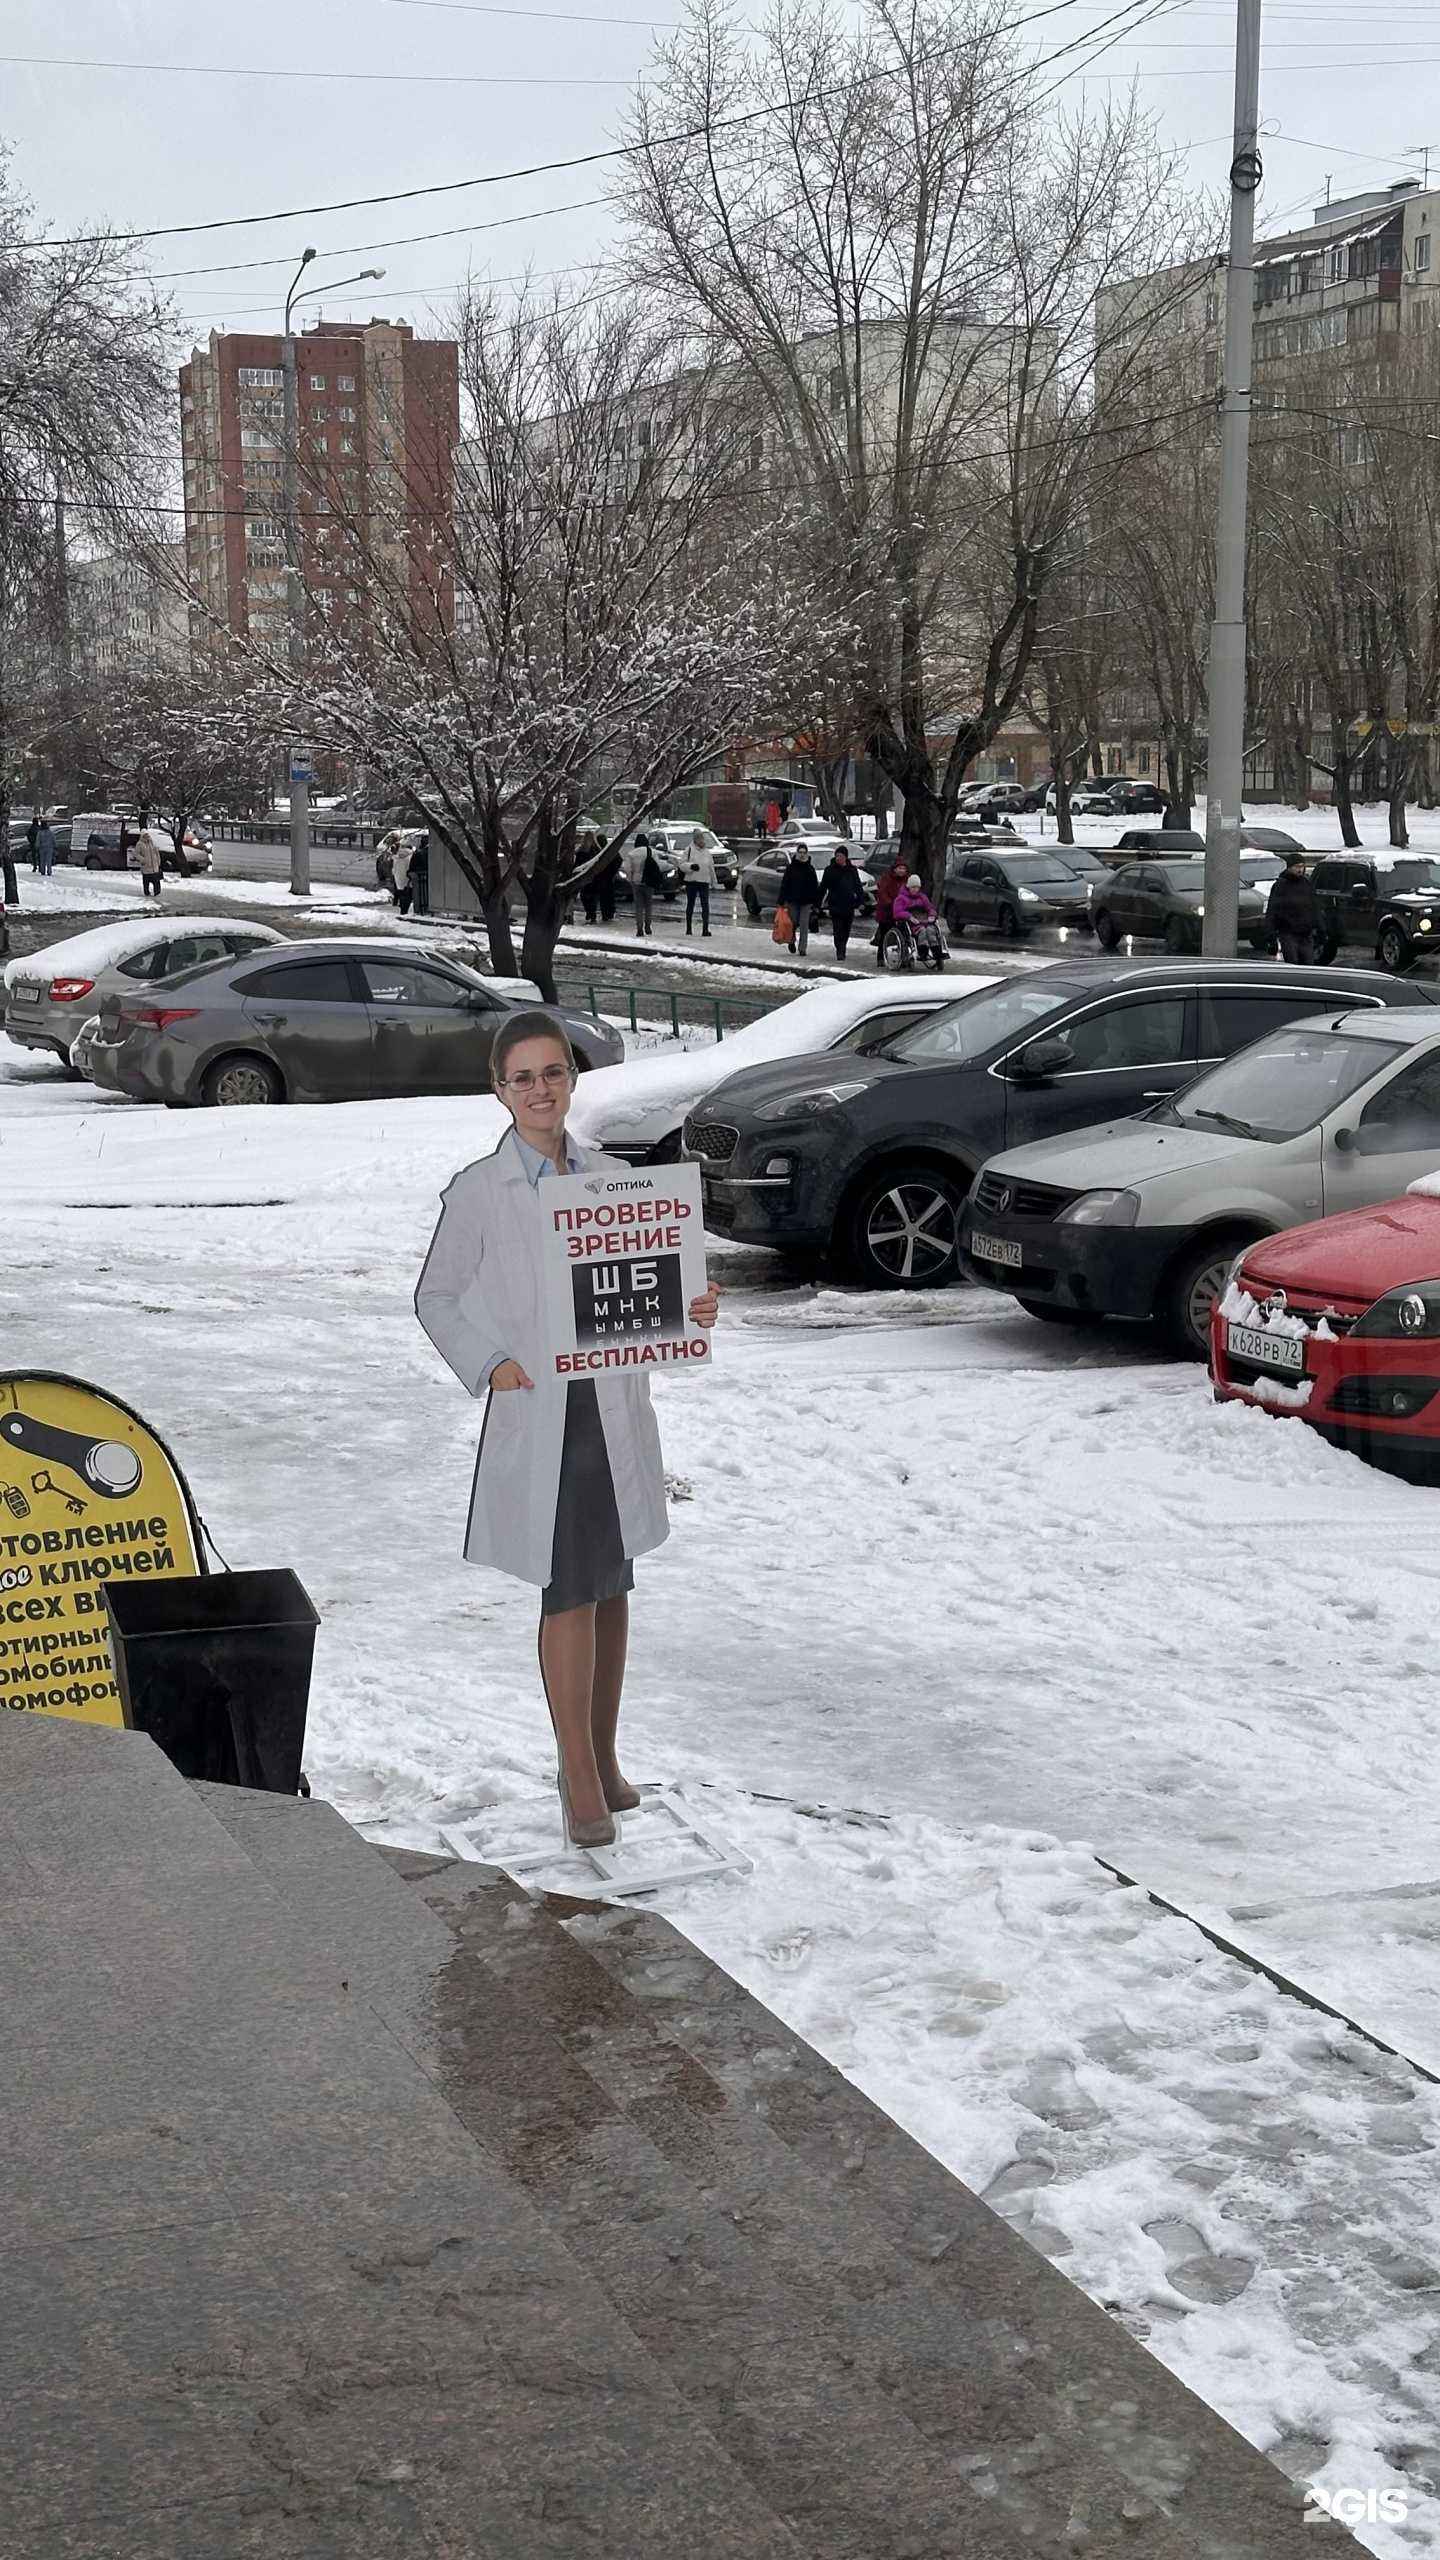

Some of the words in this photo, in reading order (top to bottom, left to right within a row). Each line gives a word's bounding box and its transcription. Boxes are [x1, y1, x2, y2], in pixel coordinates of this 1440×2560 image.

[606, 1179, 654, 1192] ОПТИКА
[553, 1198, 692, 1232] ПРОВЕРЬ
[567, 1226, 682, 1258] ЗРЕНИЕ
[555, 1338, 708, 1374] БЕСПЛАТНО
[0, 1516, 168, 1558] товление
[39, 1540, 175, 1586] ключей
